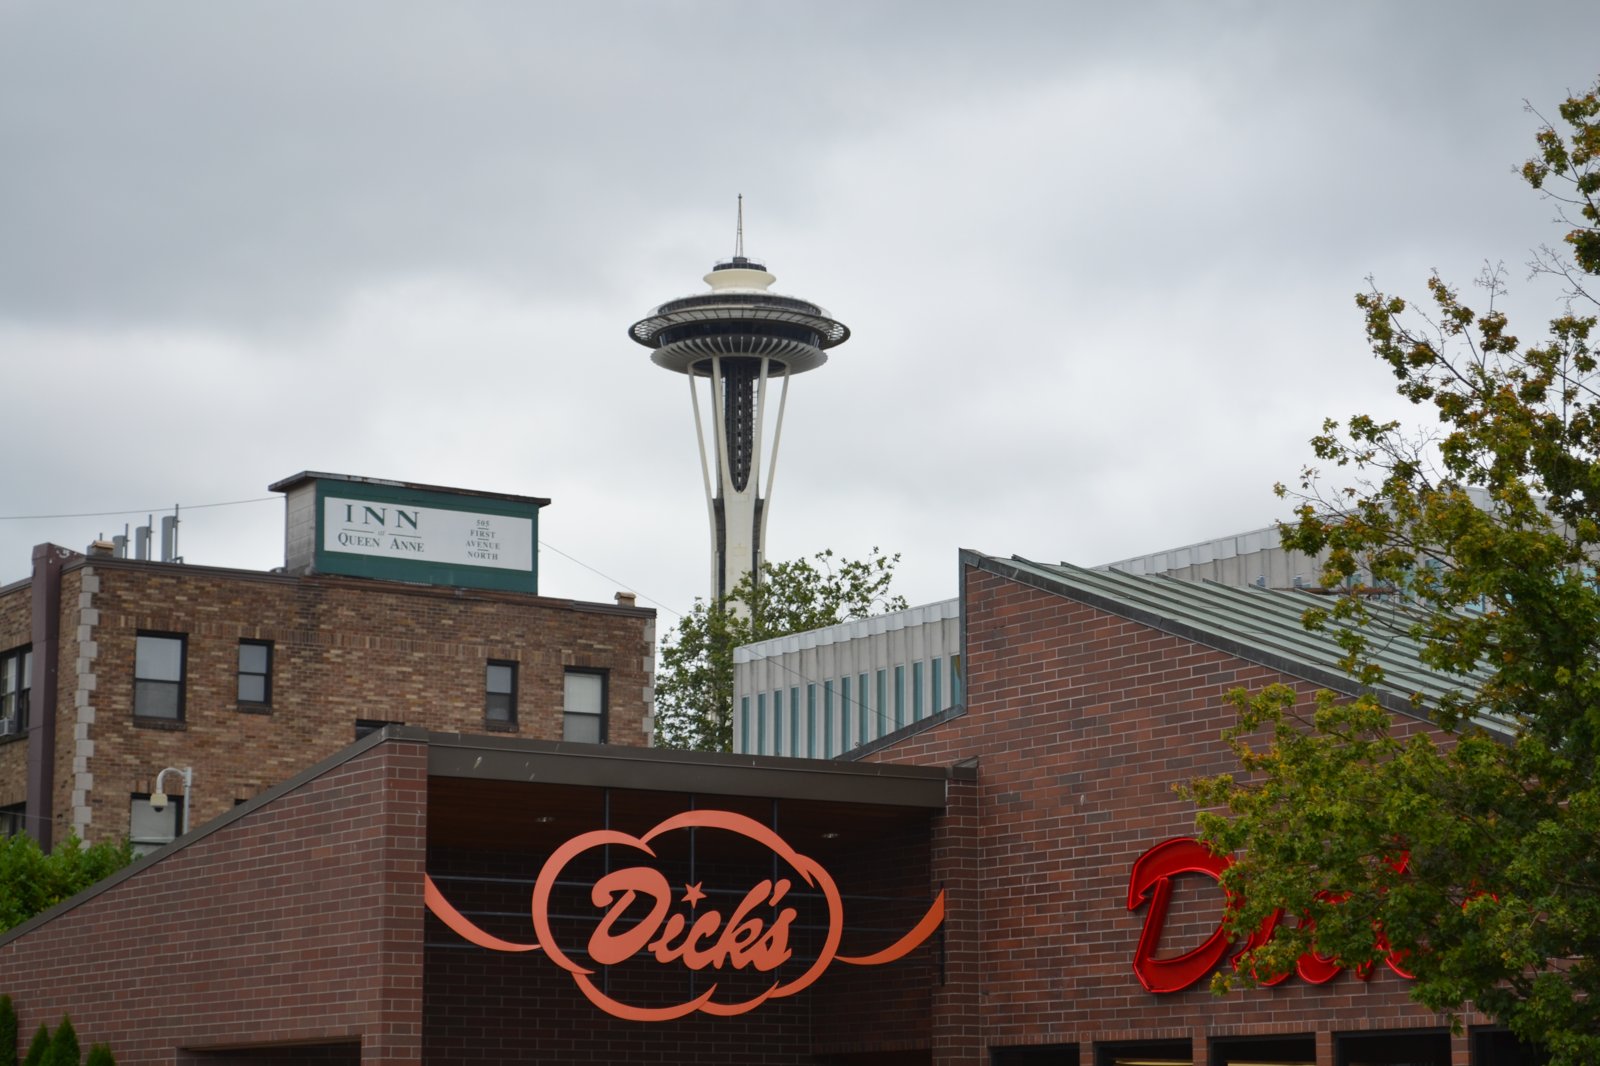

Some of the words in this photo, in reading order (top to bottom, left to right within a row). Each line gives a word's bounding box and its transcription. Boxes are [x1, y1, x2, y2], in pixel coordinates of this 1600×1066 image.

[344, 503, 420, 530] INN
[475, 519, 490, 527] 505
[470, 529, 497, 539] FIRST
[337, 531, 381, 548] QUEEN
[390, 537, 425, 553] ANNE
[466, 539, 501, 551] AVENUE
[467, 551, 499, 561] NORTH
[588, 866, 797, 972] Dick's
